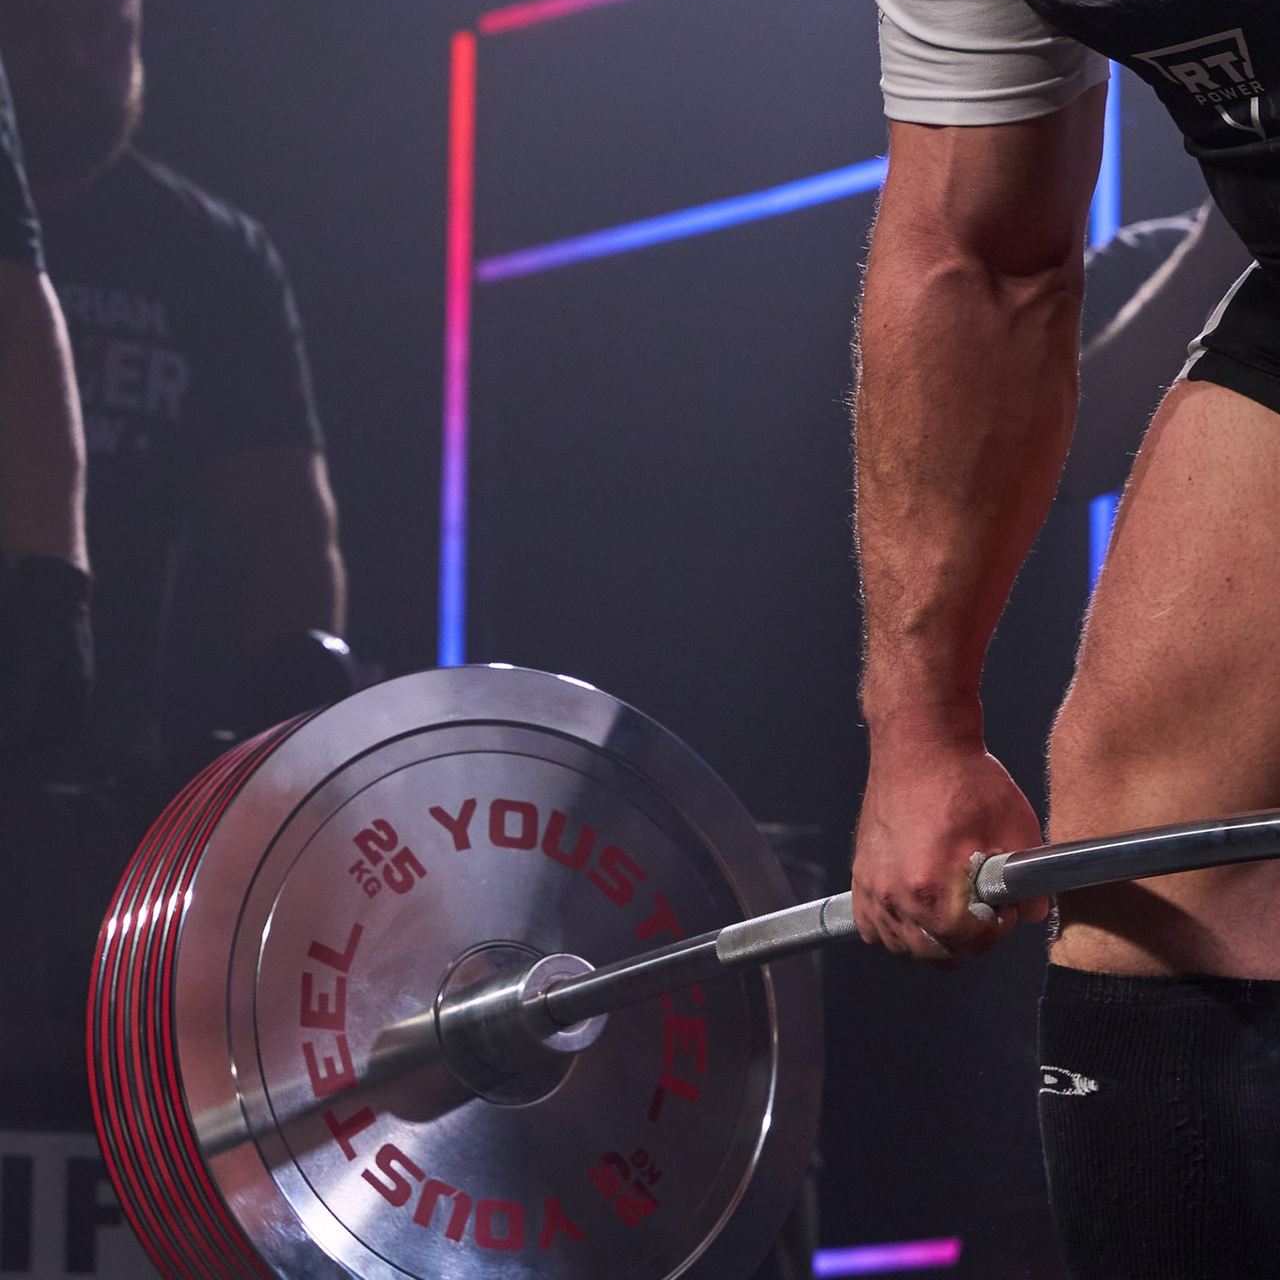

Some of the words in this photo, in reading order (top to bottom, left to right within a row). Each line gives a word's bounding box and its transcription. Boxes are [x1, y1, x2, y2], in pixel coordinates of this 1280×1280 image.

[1194, 79, 1265, 106] POWER
[82, 337, 191, 424] ER
[348, 858, 382, 898] KG
[353, 818, 427, 894] 25
[300, 922, 585, 1252] YOUSTEEL
